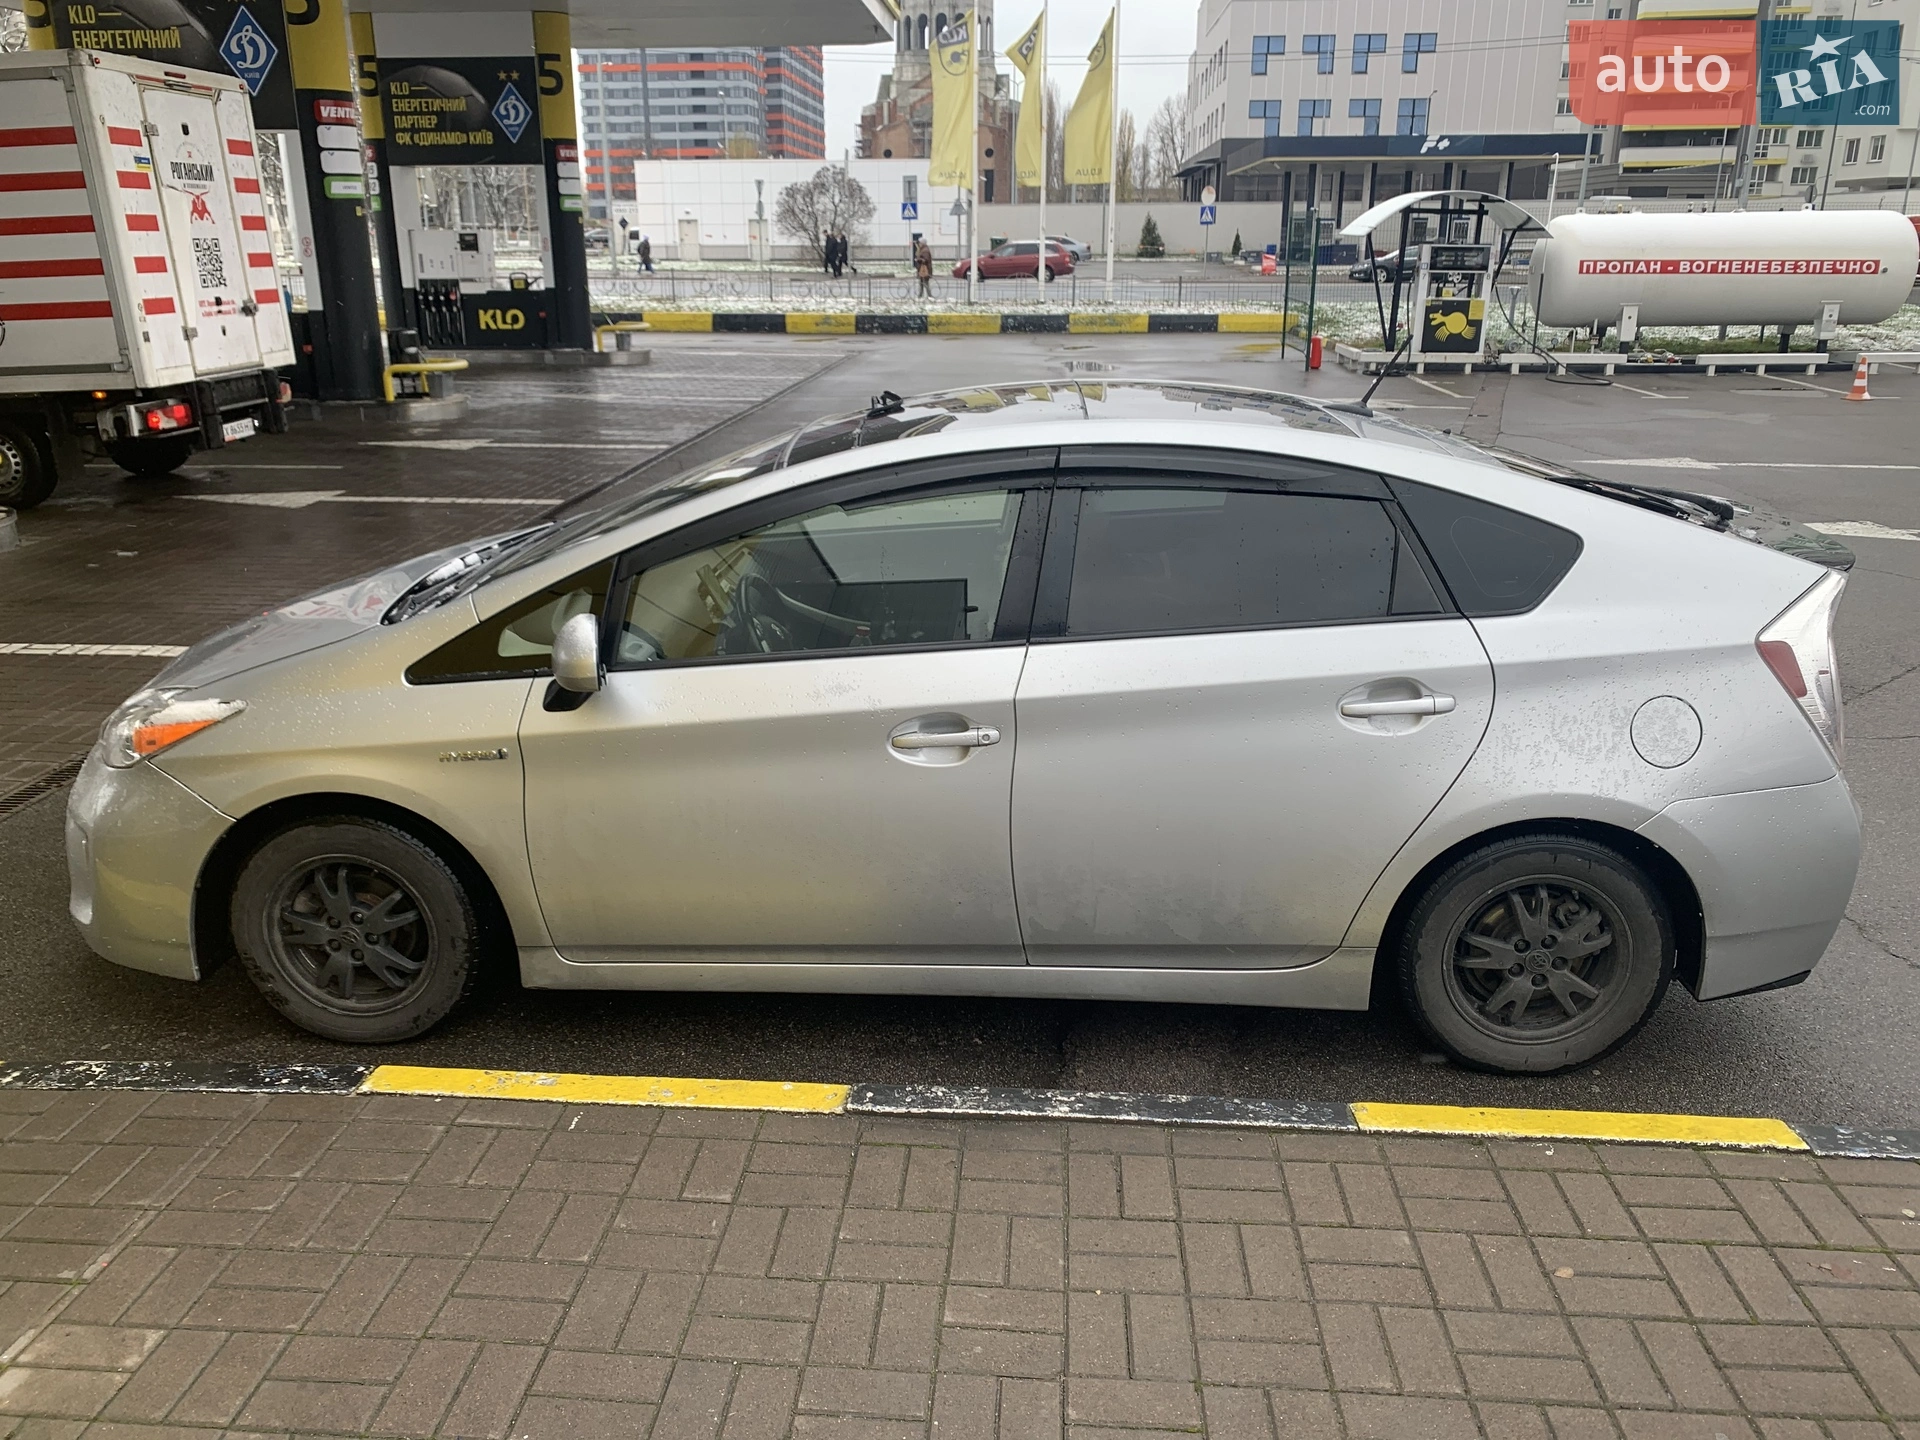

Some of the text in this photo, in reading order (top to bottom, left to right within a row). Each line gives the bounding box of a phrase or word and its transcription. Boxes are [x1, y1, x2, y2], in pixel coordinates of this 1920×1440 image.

[68, 5, 96, 24] KLO
[72, 27, 181, 49] ЕНЕРГЕТИЧНИЙ
[357, 54, 379, 97] 5
[538, 53, 563, 96] 5
[390, 82, 410, 95] KLO
[320, 105, 357, 119] VENT
[392, 97, 467, 112] ЕНЕРГЕТИЧНИЙ
[394, 116, 438, 129] ПАРТНЕР
[396, 130, 494, 146] ФК «ДИНАМО» КИЇВ
[170, 161, 215, 182] РОГАНСЬКИЙ
[1582, 261, 1662, 274] ПРОПАН
[1679, 260, 1876, 274] ВОГНЕНЕБЕЗПЕЧНО
[478, 309, 526, 330] KLO
